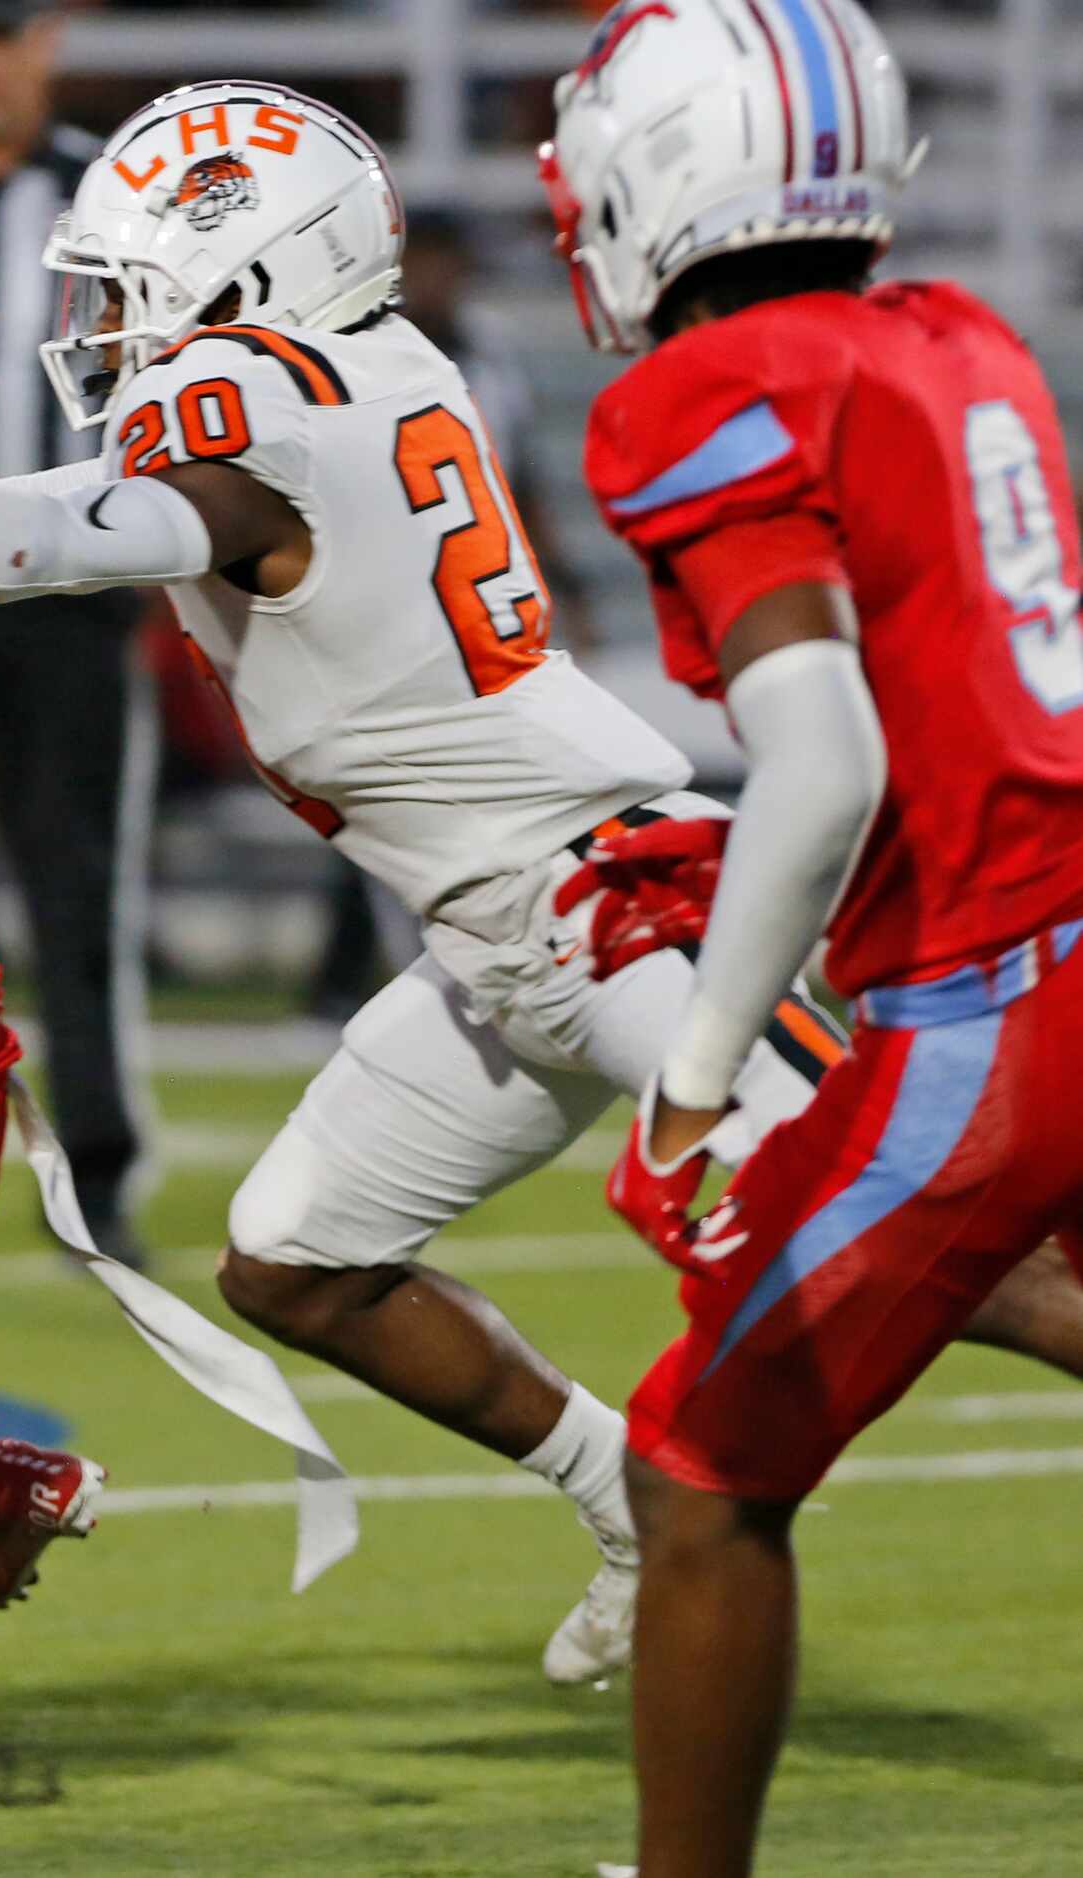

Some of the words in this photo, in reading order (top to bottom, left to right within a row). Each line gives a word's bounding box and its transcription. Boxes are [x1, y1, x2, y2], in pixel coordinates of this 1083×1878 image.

[113, 104, 306, 192] LHS
[814, 131, 839, 178] 9
[118, 377, 251, 477] 20
[394, 402, 551, 697] 2
[964, 398, 1083, 716] 9
